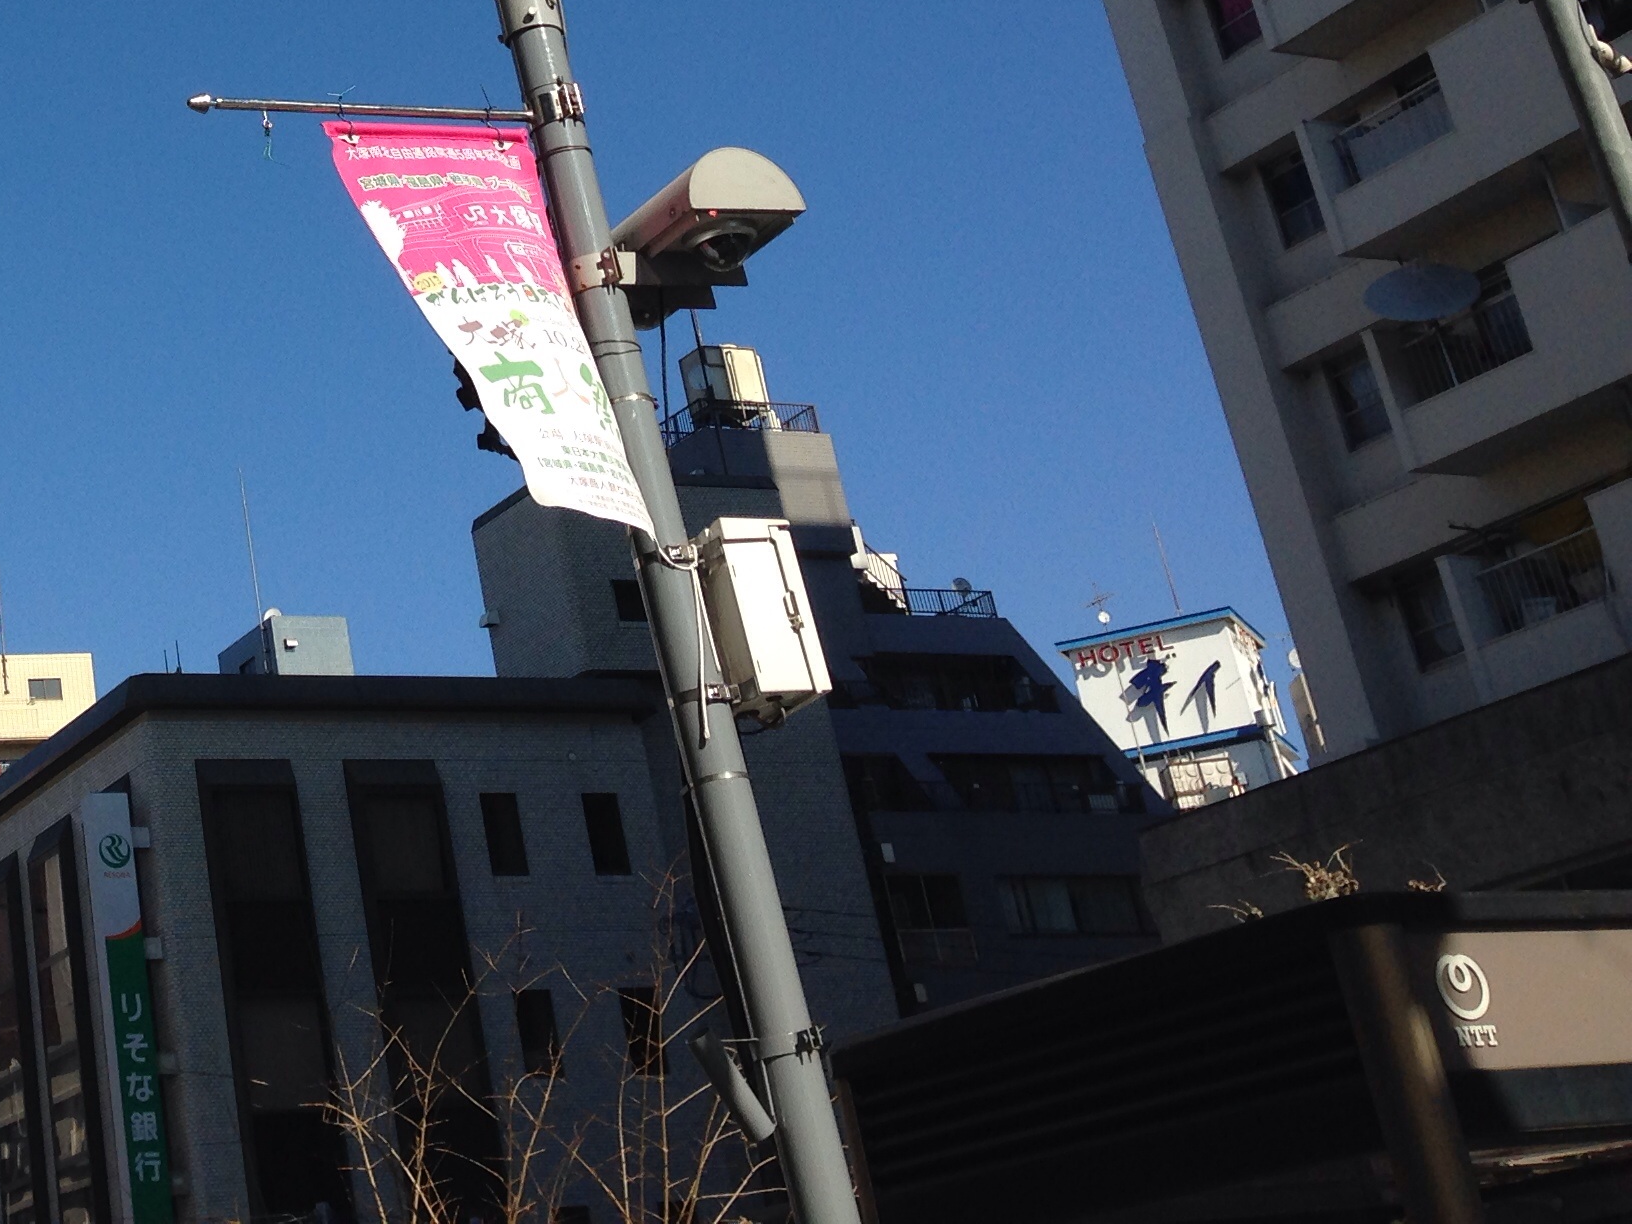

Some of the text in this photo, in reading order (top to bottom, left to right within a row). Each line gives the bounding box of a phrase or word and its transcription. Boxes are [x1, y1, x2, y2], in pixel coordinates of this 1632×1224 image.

[457, 316, 536, 350] 大塚
[1078, 635, 1174, 667] HOTEL
[1454, 1024, 1499, 1047] NTT
[120, 992, 161, 1183] りそな銀行
